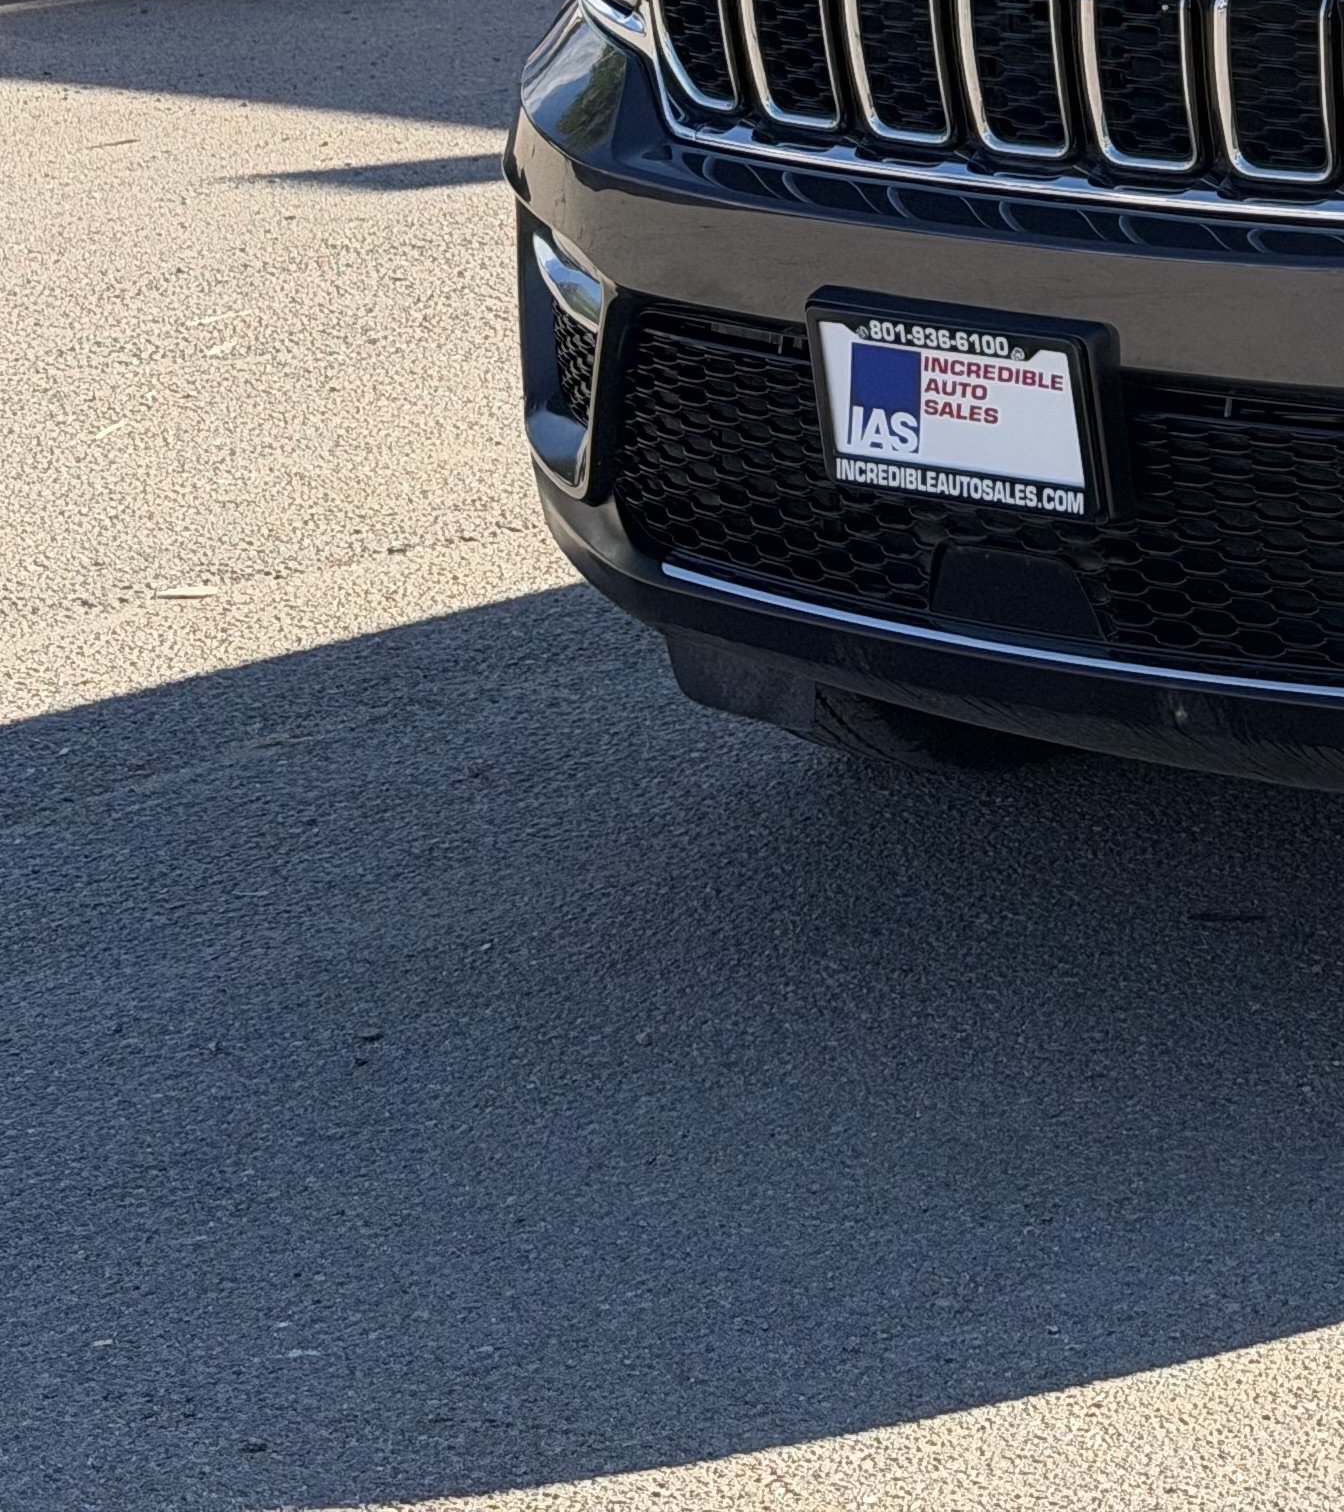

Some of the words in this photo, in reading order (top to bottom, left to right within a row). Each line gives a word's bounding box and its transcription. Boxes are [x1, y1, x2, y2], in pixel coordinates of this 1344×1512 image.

[868, 320, 1009, 356] 801-936-6100
[923, 355, 1064, 392] INCREDIBLE
[923, 378, 988, 401] AUTO
[848, 405, 919, 454] IAS
[923, 400, 999, 425] SALES
[835, 458, 1085, 515] INCREDIBLEAUTOSALES.COM
